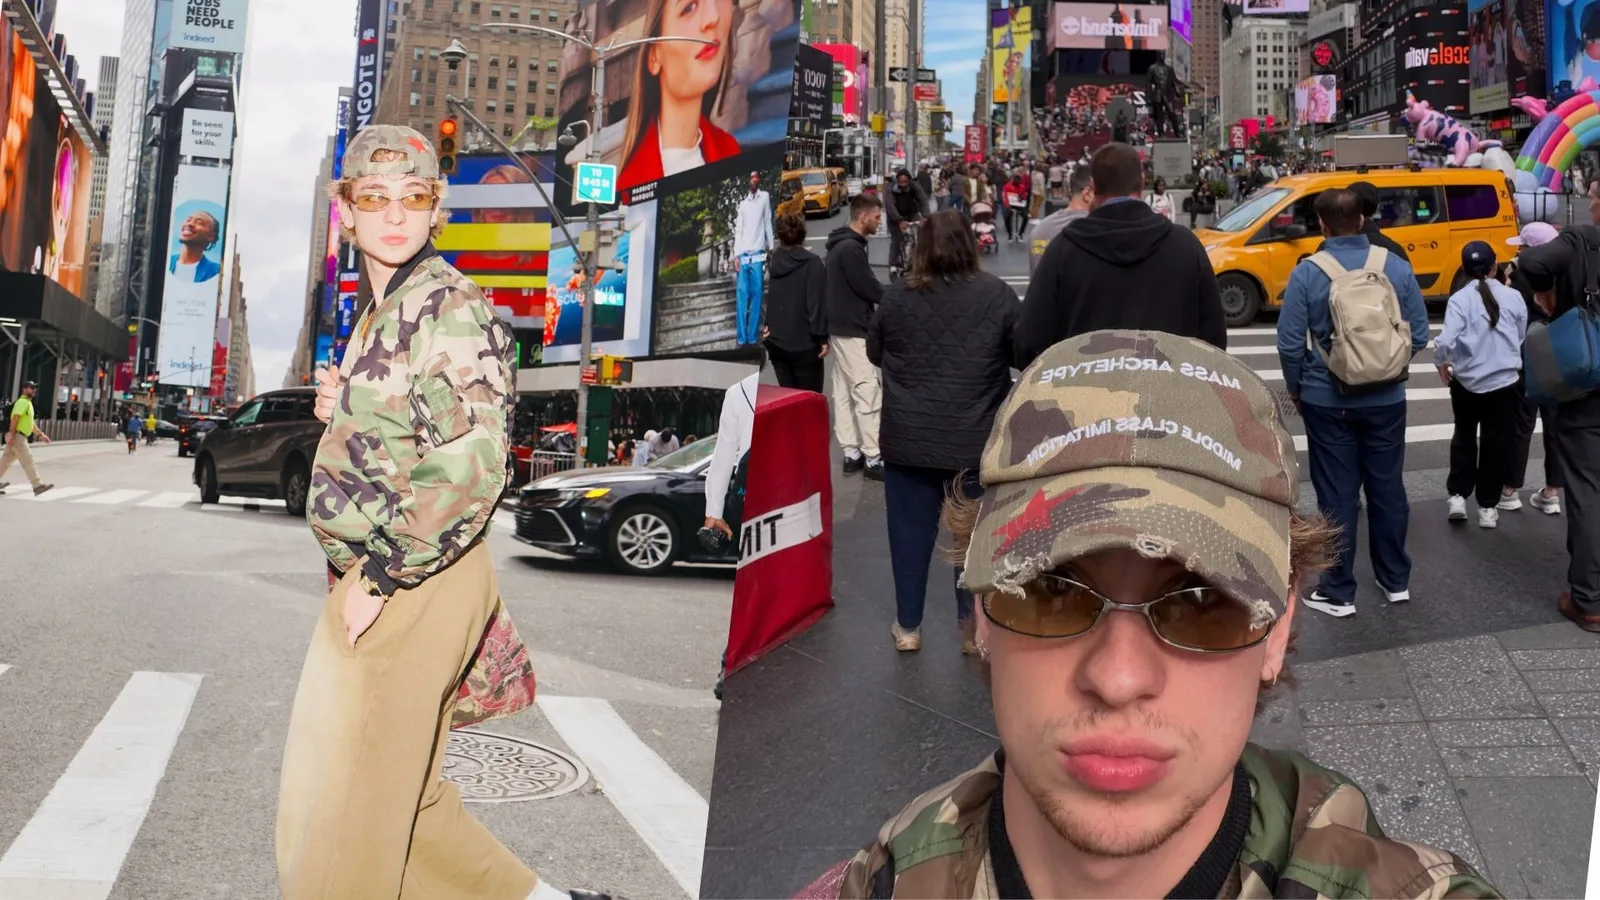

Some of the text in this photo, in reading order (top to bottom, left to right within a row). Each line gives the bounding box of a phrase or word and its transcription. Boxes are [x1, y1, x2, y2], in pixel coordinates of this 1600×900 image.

[188, 0, 220, 8] JOBS
[187, 6, 219, 17] NEED
[186, 16, 234, 29] PEOPLE
[184, 33, 214, 43] indeed
[192, 119, 223, 129] Be seen
[591, 167, 603, 177] TO
